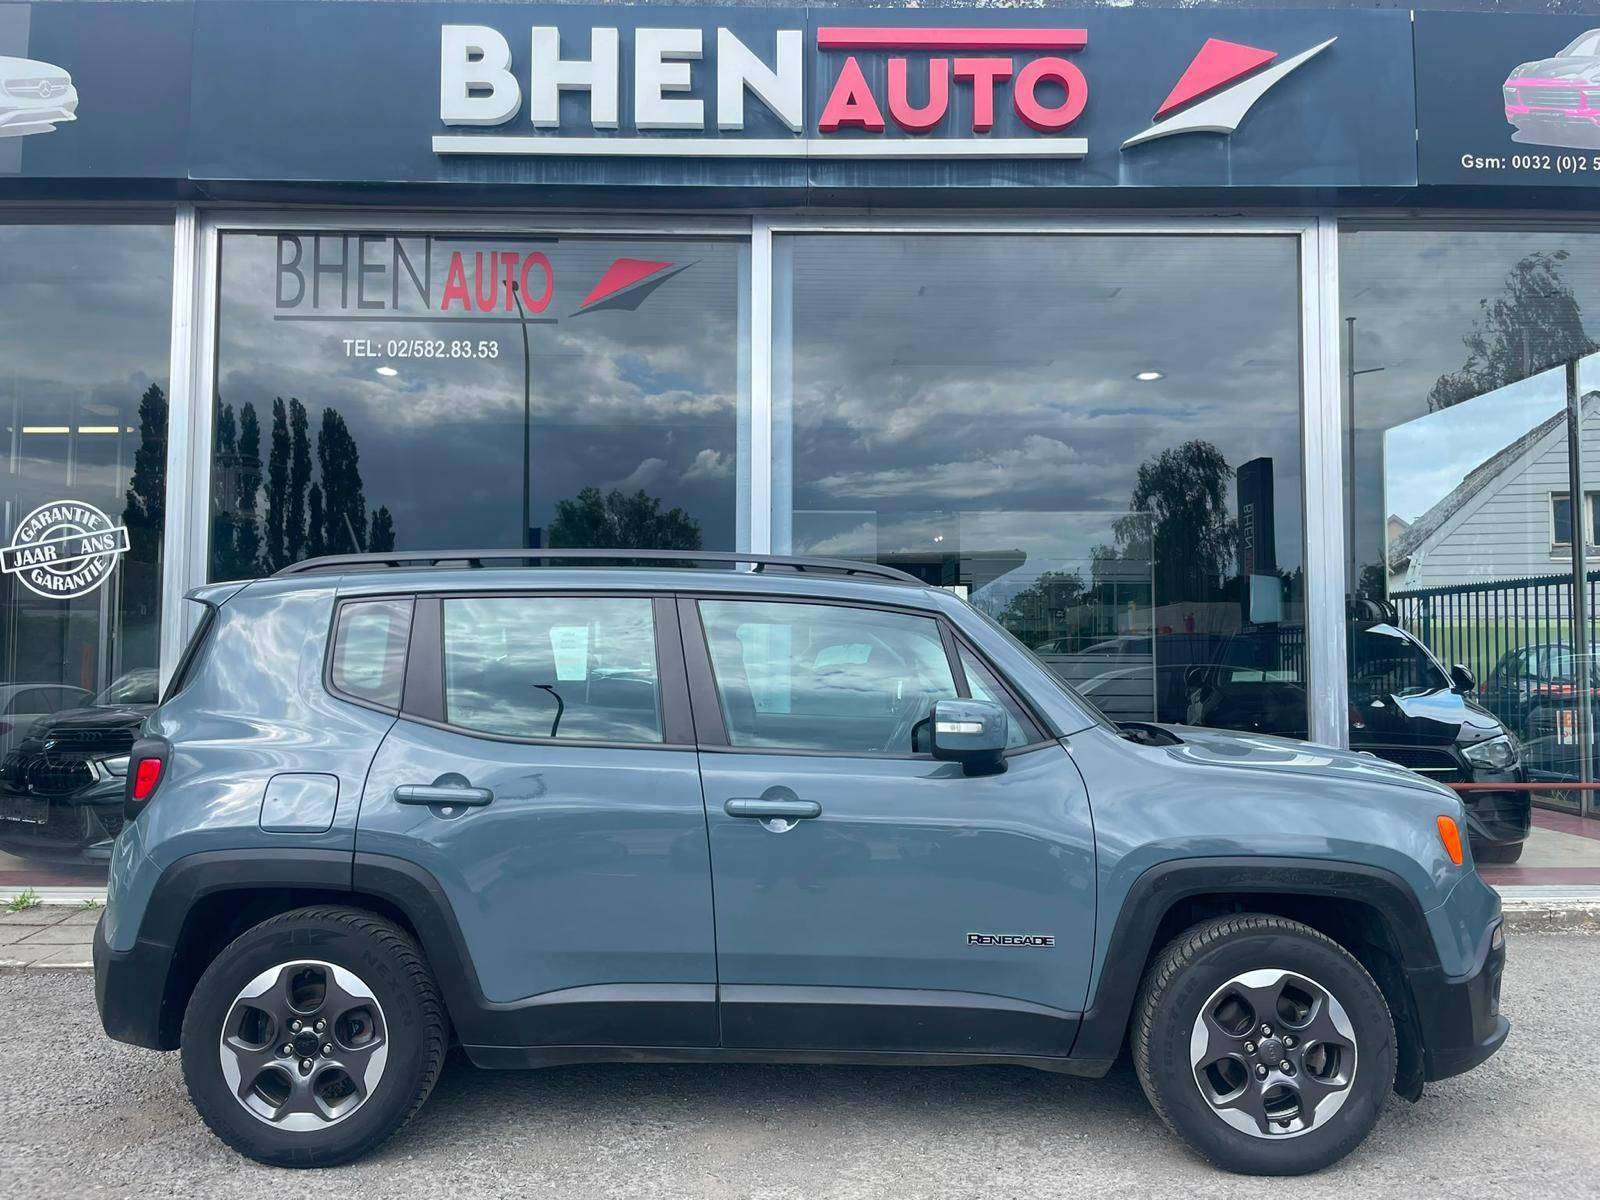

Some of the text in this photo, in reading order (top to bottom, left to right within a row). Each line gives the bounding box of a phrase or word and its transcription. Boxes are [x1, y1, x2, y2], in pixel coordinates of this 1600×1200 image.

[440, 25, 1089, 133] BHEN AUTO
[1461, 154, 1506, 169] Gsm:
[1512, 155, 1551, 170] 0032
[1556, 155, 1587, 173] (0)2
[275, 233, 554, 314] BHEN AUTO
[343, 339, 499, 358] TEL: 02/582.83.53
[20, 506, 101, 542] GARANTIE
[14, 533, 115, 567] JAAR ANS
[31, 554, 107, 591] GARANTIE
[966, 933, 1055, 947] RENEGADE
